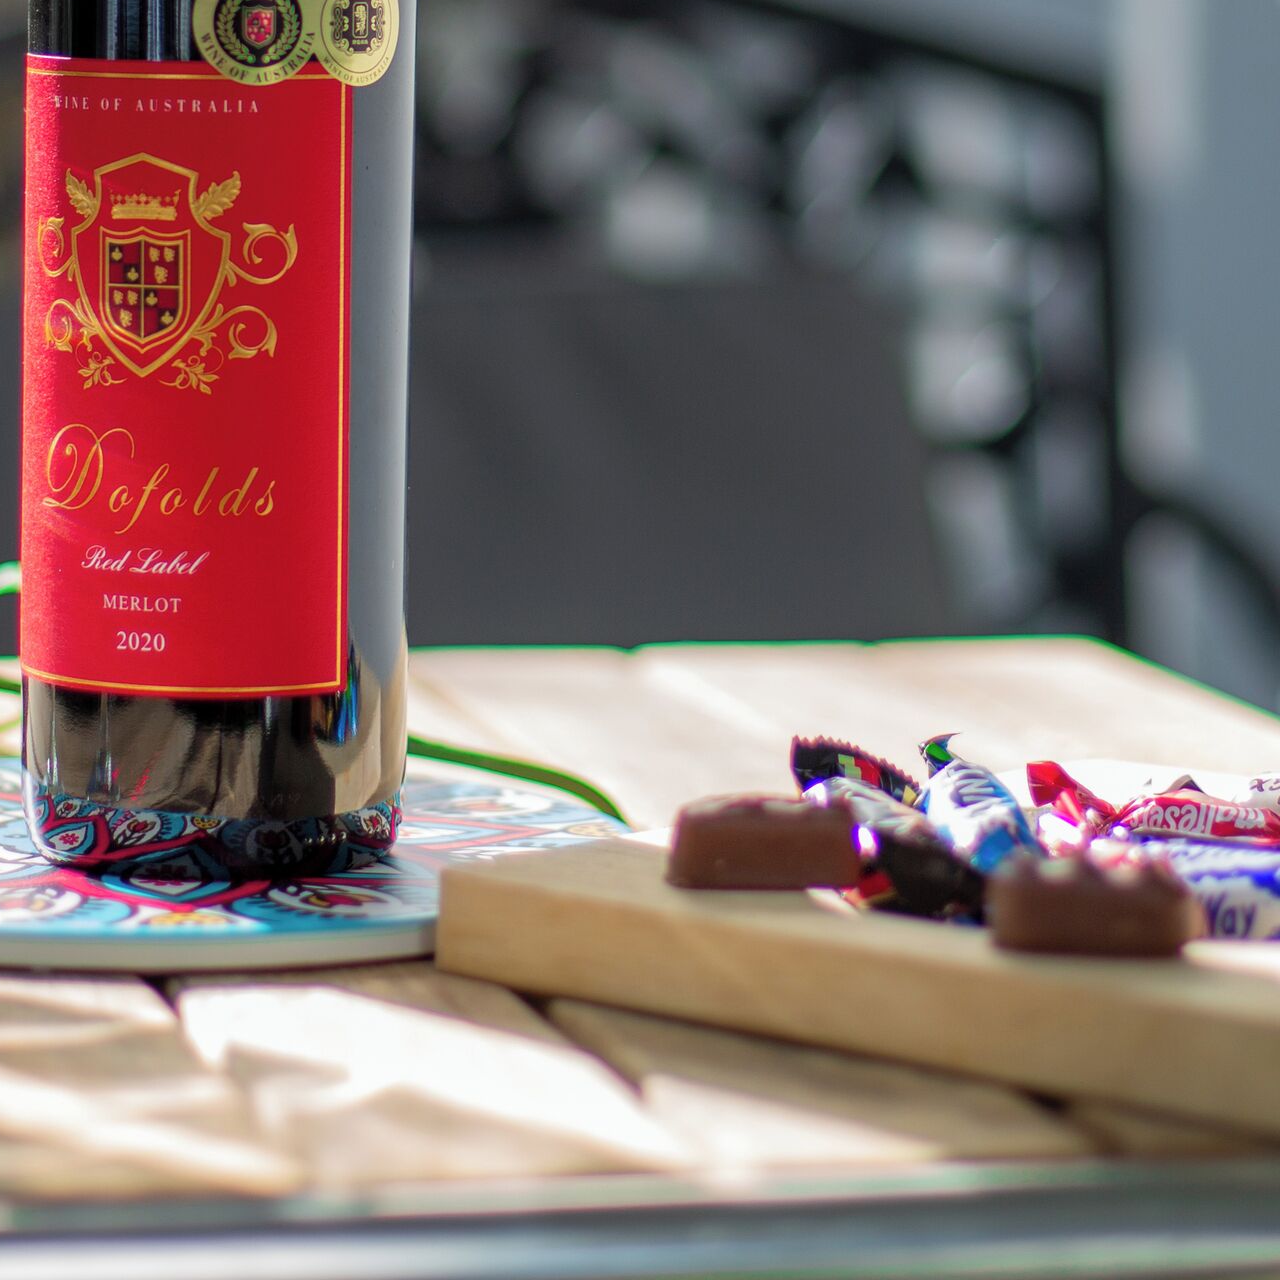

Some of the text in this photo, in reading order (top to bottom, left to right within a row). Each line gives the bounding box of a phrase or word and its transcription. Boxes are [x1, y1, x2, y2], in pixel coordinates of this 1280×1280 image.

[201, 32, 315, 83] WINE OF AUSTRALIA
[323, 56, 389, 83] WINE OF AUSTRALIA
[54, 95, 259, 113] WINE OF AUSTRALIA
[42, 423, 276, 534] Dofolds
[81, 545, 210, 575] Red Label
[103, 594, 182, 613] MERLOT
[116, 631, 166, 652] 2020
